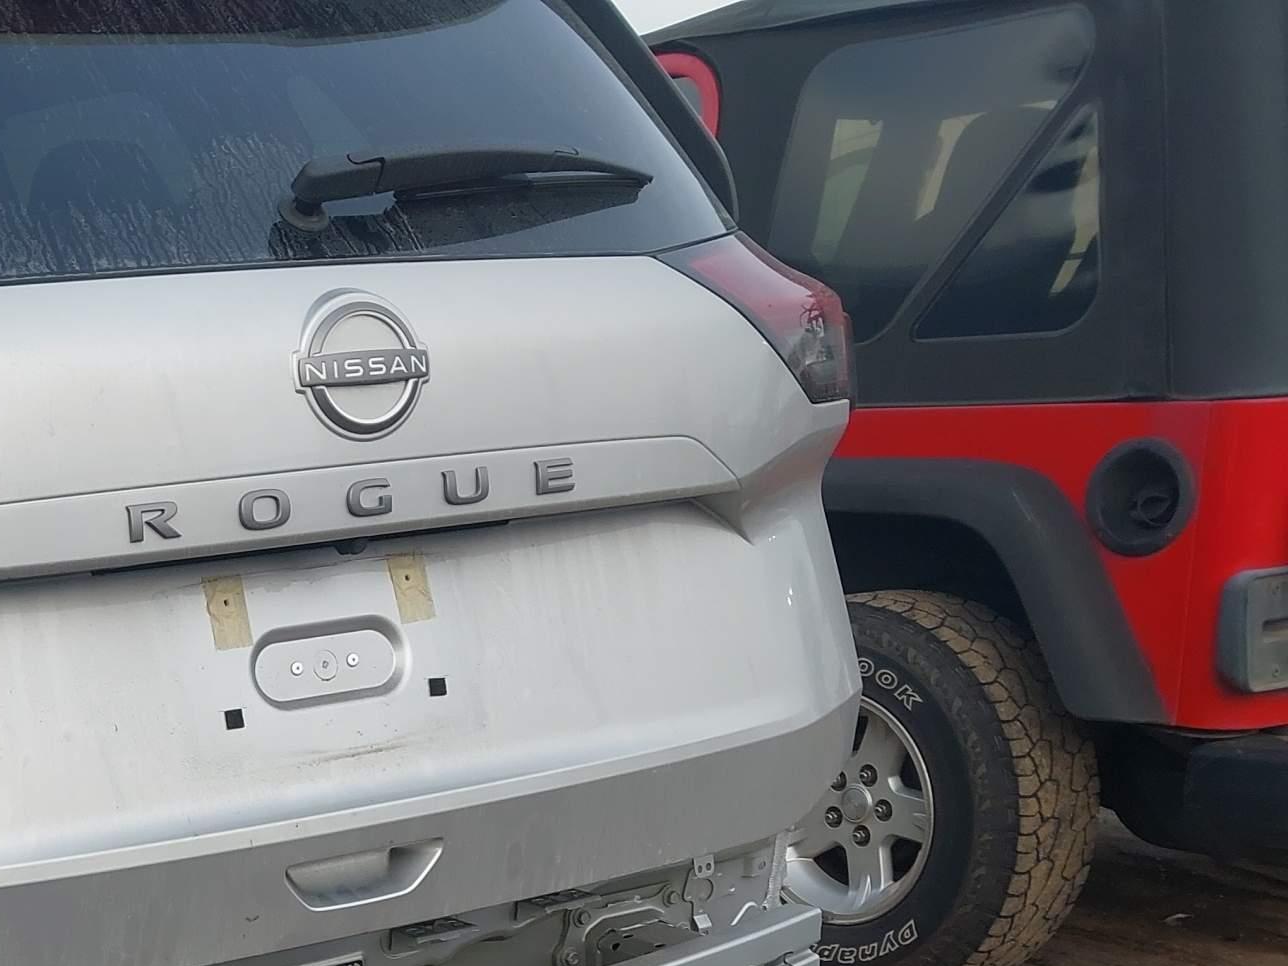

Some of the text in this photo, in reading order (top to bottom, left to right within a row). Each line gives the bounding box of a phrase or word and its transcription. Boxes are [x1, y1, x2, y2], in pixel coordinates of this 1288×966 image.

[305, 353, 427, 382] NISSAN
[125, 457, 576, 543] ROGUE
[812, 918, 919, 964] Dynap
